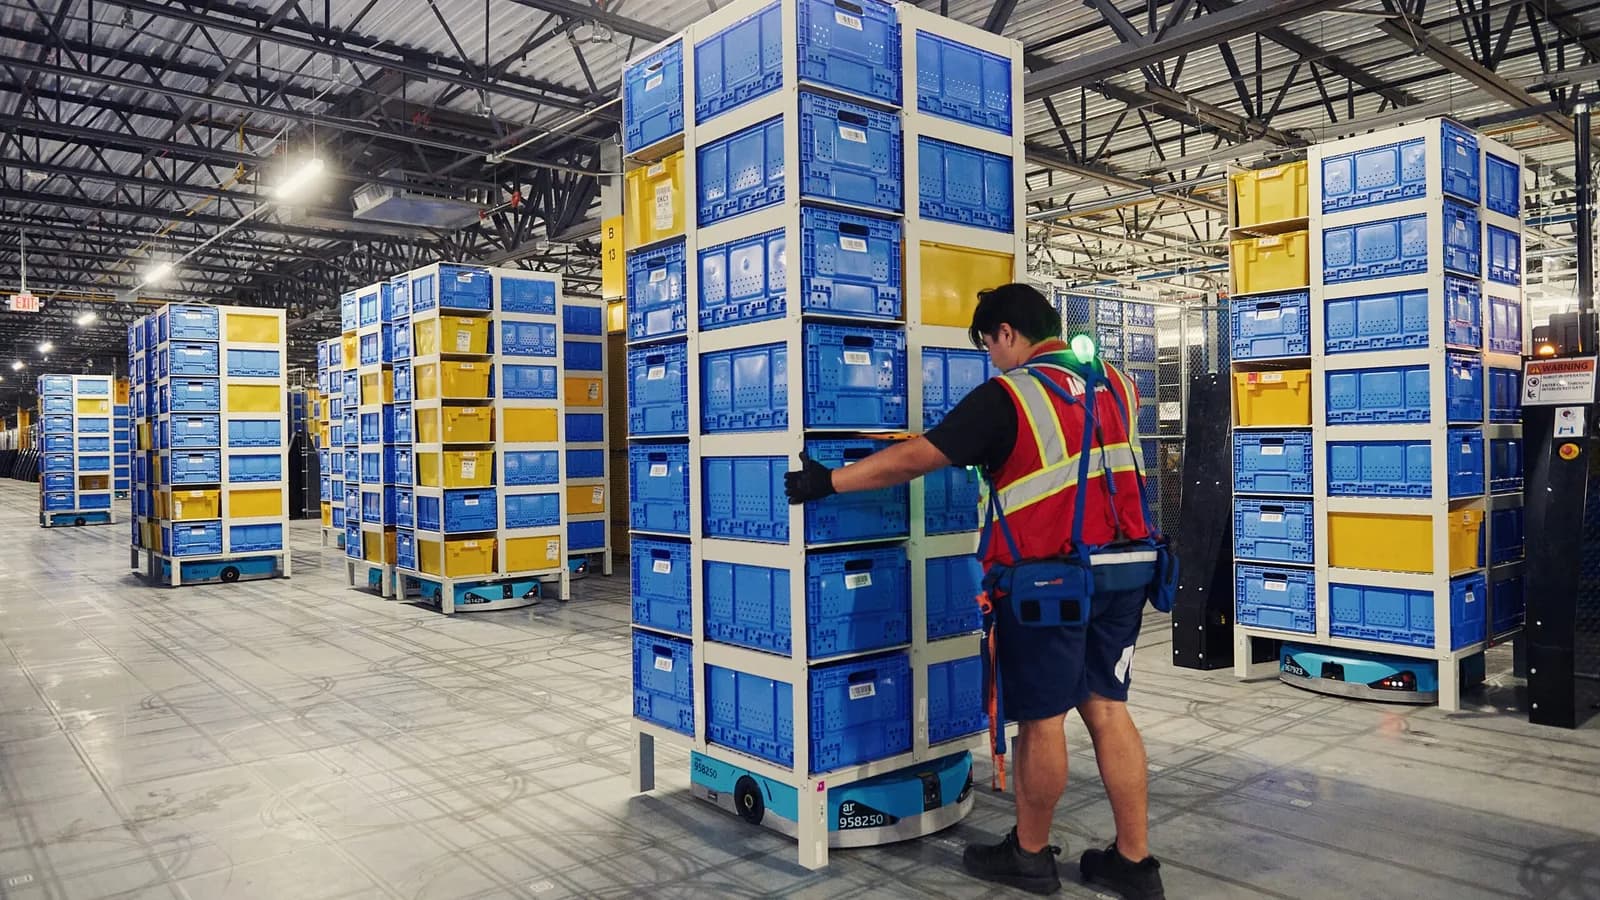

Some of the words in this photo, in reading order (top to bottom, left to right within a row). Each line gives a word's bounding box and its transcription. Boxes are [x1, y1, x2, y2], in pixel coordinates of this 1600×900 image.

[608, 248, 616, 261] 13
[16, 296, 37, 310] EXIT
[1542, 362, 1588, 372] WARNING
[693, 760, 718, 779] 958250
[839, 813, 884, 828] 958250
